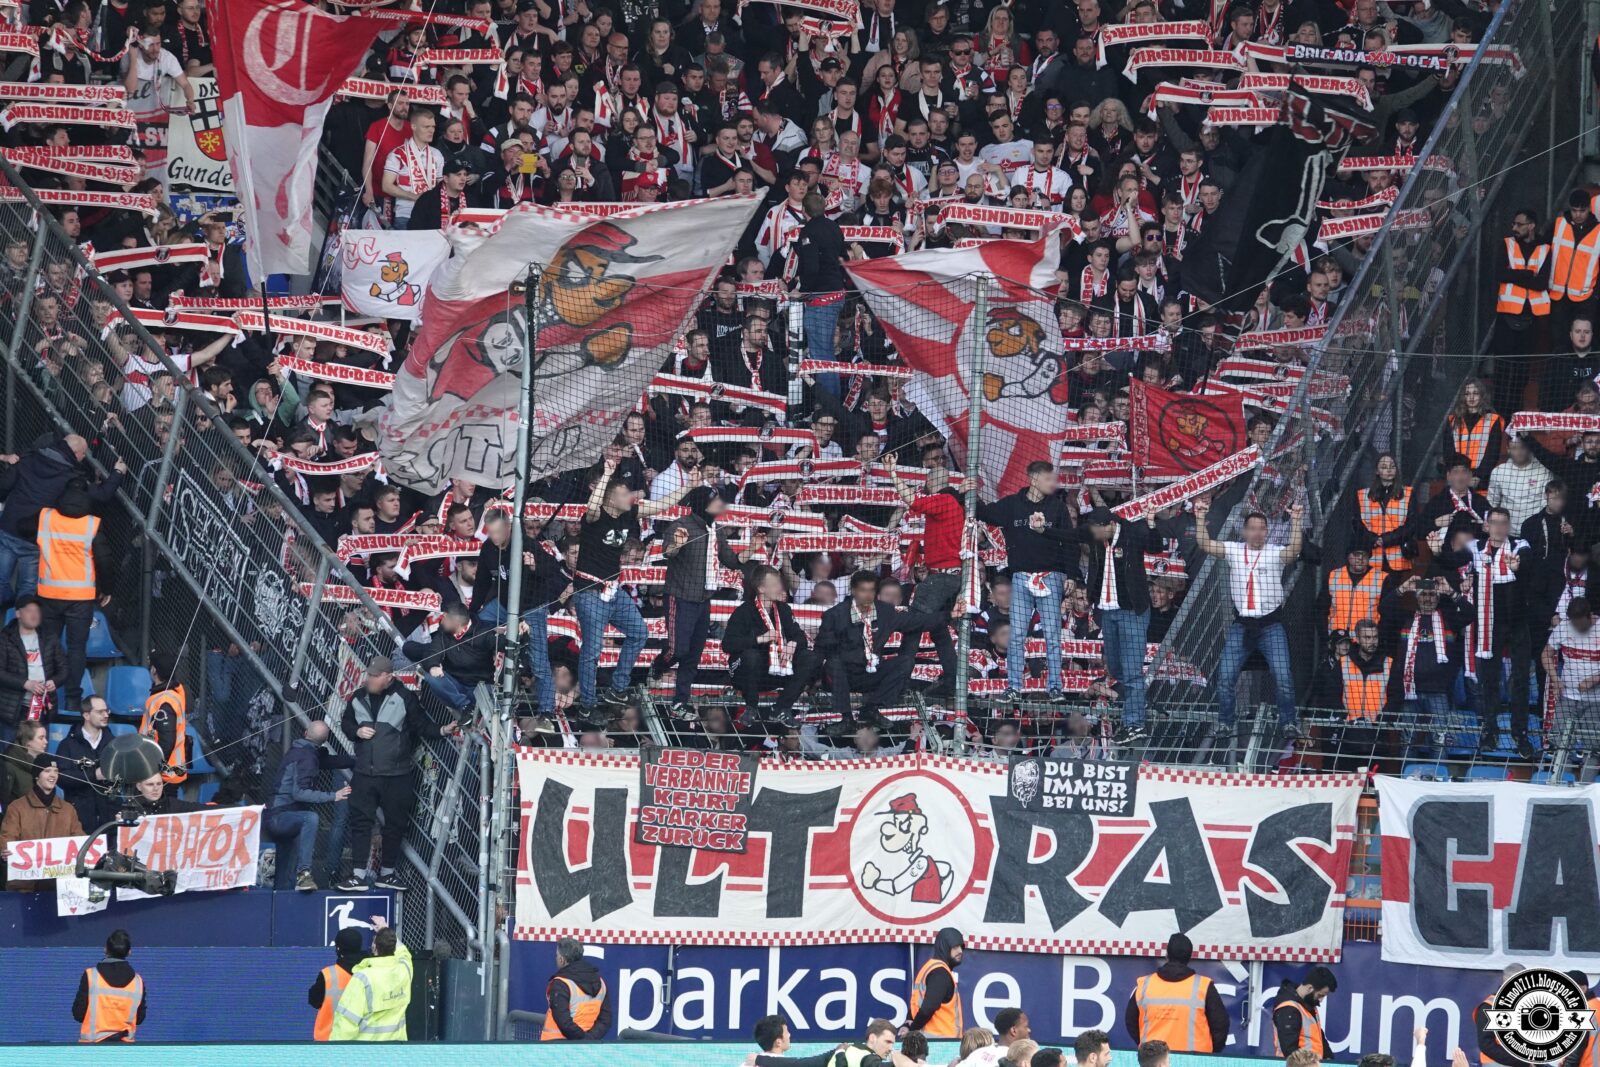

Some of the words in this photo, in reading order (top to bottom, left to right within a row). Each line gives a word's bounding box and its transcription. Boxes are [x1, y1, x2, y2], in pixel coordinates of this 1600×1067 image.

[429, 49, 465, 60] SIND
[470, 48, 501, 59] DER
[1161, 50, 1196, 62] SIND
[1202, 51, 1233, 63] DER
[1295, 44, 1366, 63] BRIGADA
[1, 85, 40, 97] SIND
[44, 86, 78, 98] DER
[349, 80, 385, 95] SIND
[1309, 78, 1341, 91] DER
[12, 105, 42, 118] WIR
[46, 106, 80, 119] SIND
[83, 108, 112, 121] DER
[1247, 110, 1280, 121] SIN
[43, 146, 80, 158] SIND
[84, 145, 113, 157] DER
[23, 152, 62, 169] SIND
[66, 160, 98, 176] DER
[1343, 156, 1379, 168] SIND
[37, 190, 71, 201] IND
[77, 191, 111, 203] DER
[972, 208, 1010, 223] SIND
[1014, 212, 1046, 227] DER
[860, 226, 893, 238] DER
[215, 297, 250, 307] SIND
[280, 319, 319, 335] SIND
[323, 326, 355, 342] DER
[311, 363, 349, 379] SIND
[353, 369, 386, 385] DER
[1513, 414, 1547, 428] WIR
[1552, 415, 1594, 429] SIND
[1187, 469, 1218, 493] DER
[818, 488, 856, 501] SIND
[861, 489, 894, 502] DER
[439, 541, 479, 553] SIND
[799, 536, 838, 550] SIND
[842, 536, 874, 551] DER
[375, 589, 406, 604] DER
[658, 748, 741, 771] JEDER
[1044, 760, 1073, 777] DU
[1083, 763, 1131, 780] BIST
[645, 763, 751, 794] VERBANNTE
[1043, 777, 1128, 799] IMMER
[653, 788, 740, 812] KEHRT
[1042, 794, 1073, 809] BEI
[1081, 797, 1129, 813] UNS!
[118, 810, 259, 872] KARAZOR
[642, 825, 744, 850] ZURÜCK
[11, 838, 104, 870] SILAS
[583, 946, 1021, 1039] parkase
[1061, 955, 1461, 1060] Bhum
